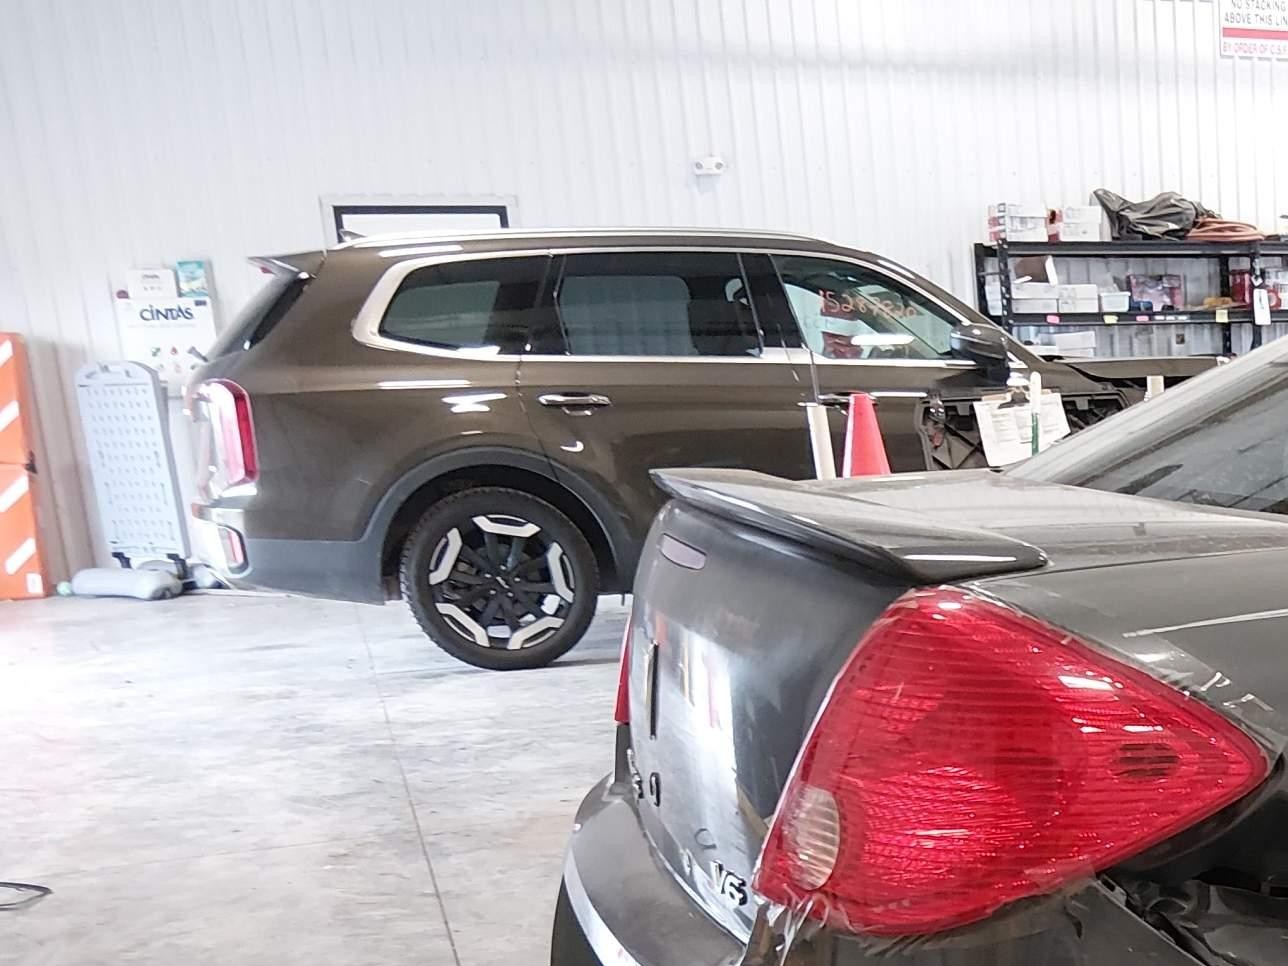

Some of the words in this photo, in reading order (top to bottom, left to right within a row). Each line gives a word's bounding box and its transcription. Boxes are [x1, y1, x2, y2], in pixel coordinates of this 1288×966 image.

[1245, 0, 1286, 12] STACKING
[1224, 12, 1252, 24] ABOVE
[1254, 14, 1273, 26] THIS
[1223, 41, 1232, 52] BY
[1234, 42, 1257, 54] ORDER
[1259, 43, 1269, 54] OF
